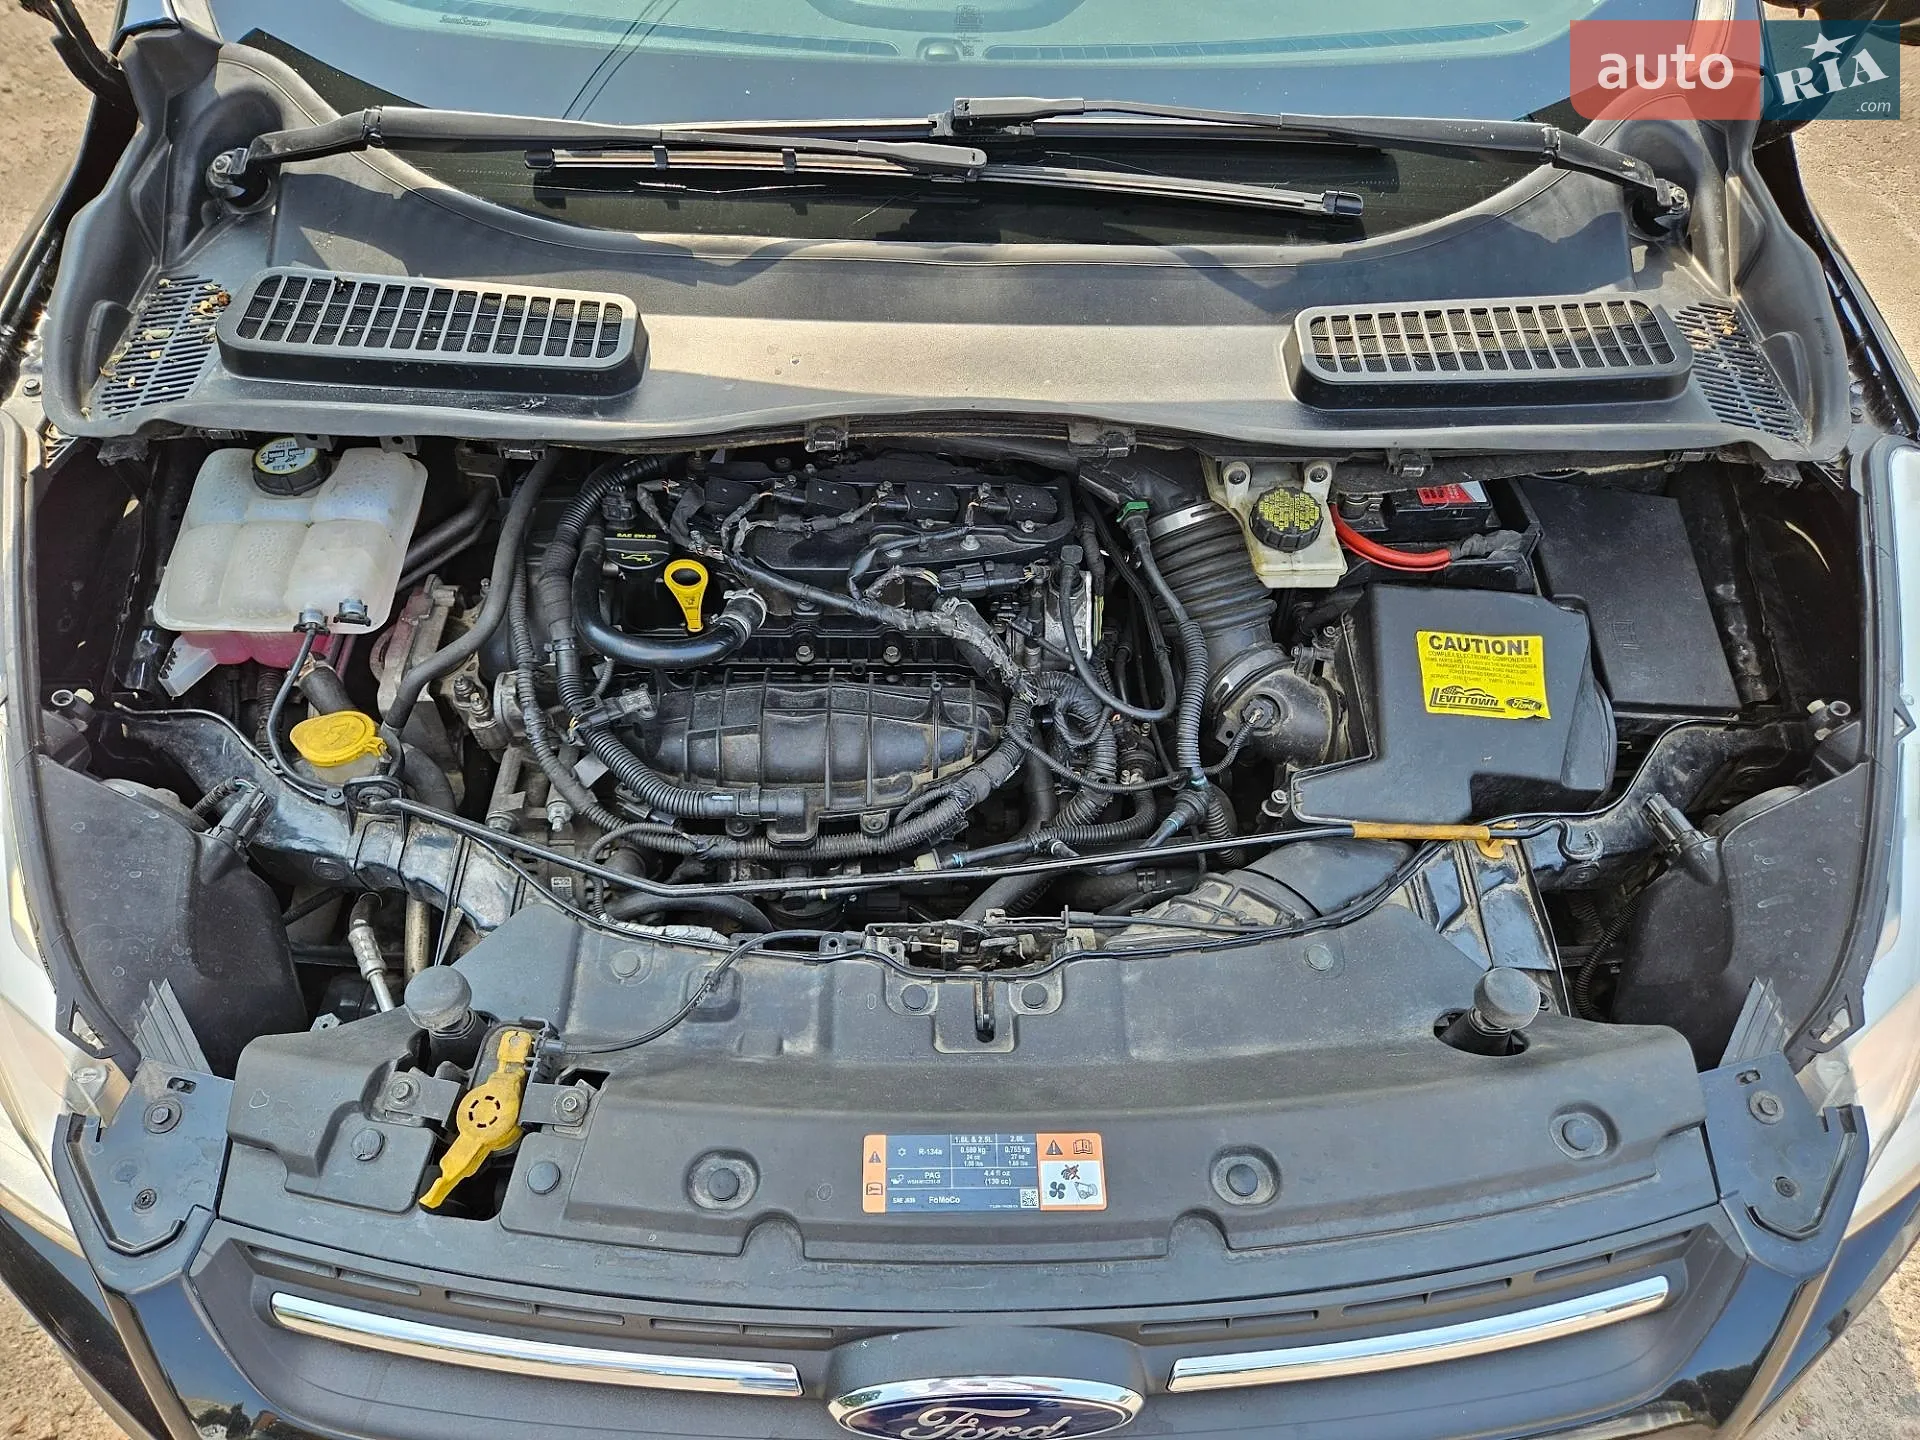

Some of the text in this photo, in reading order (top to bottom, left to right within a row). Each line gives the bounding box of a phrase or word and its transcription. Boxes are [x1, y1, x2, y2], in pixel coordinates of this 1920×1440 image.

[1428, 634, 1530, 657] CAUTION!
[1429, 687, 1505, 713] LEVITTOWN
[918, 1147, 943, 1156] R-134a
[977, 1146, 986, 1155] kg
[1021, 1146, 1031, 1156] kg
[924, 1171, 941, 1179] PAG
[984, 1169, 995, 1177] 4.4
[1000, 1177, 1012, 1187] cc)
[927, 1195, 961, 1205] FoMoCo
[899, 1405, 1074, 1440] Ford
